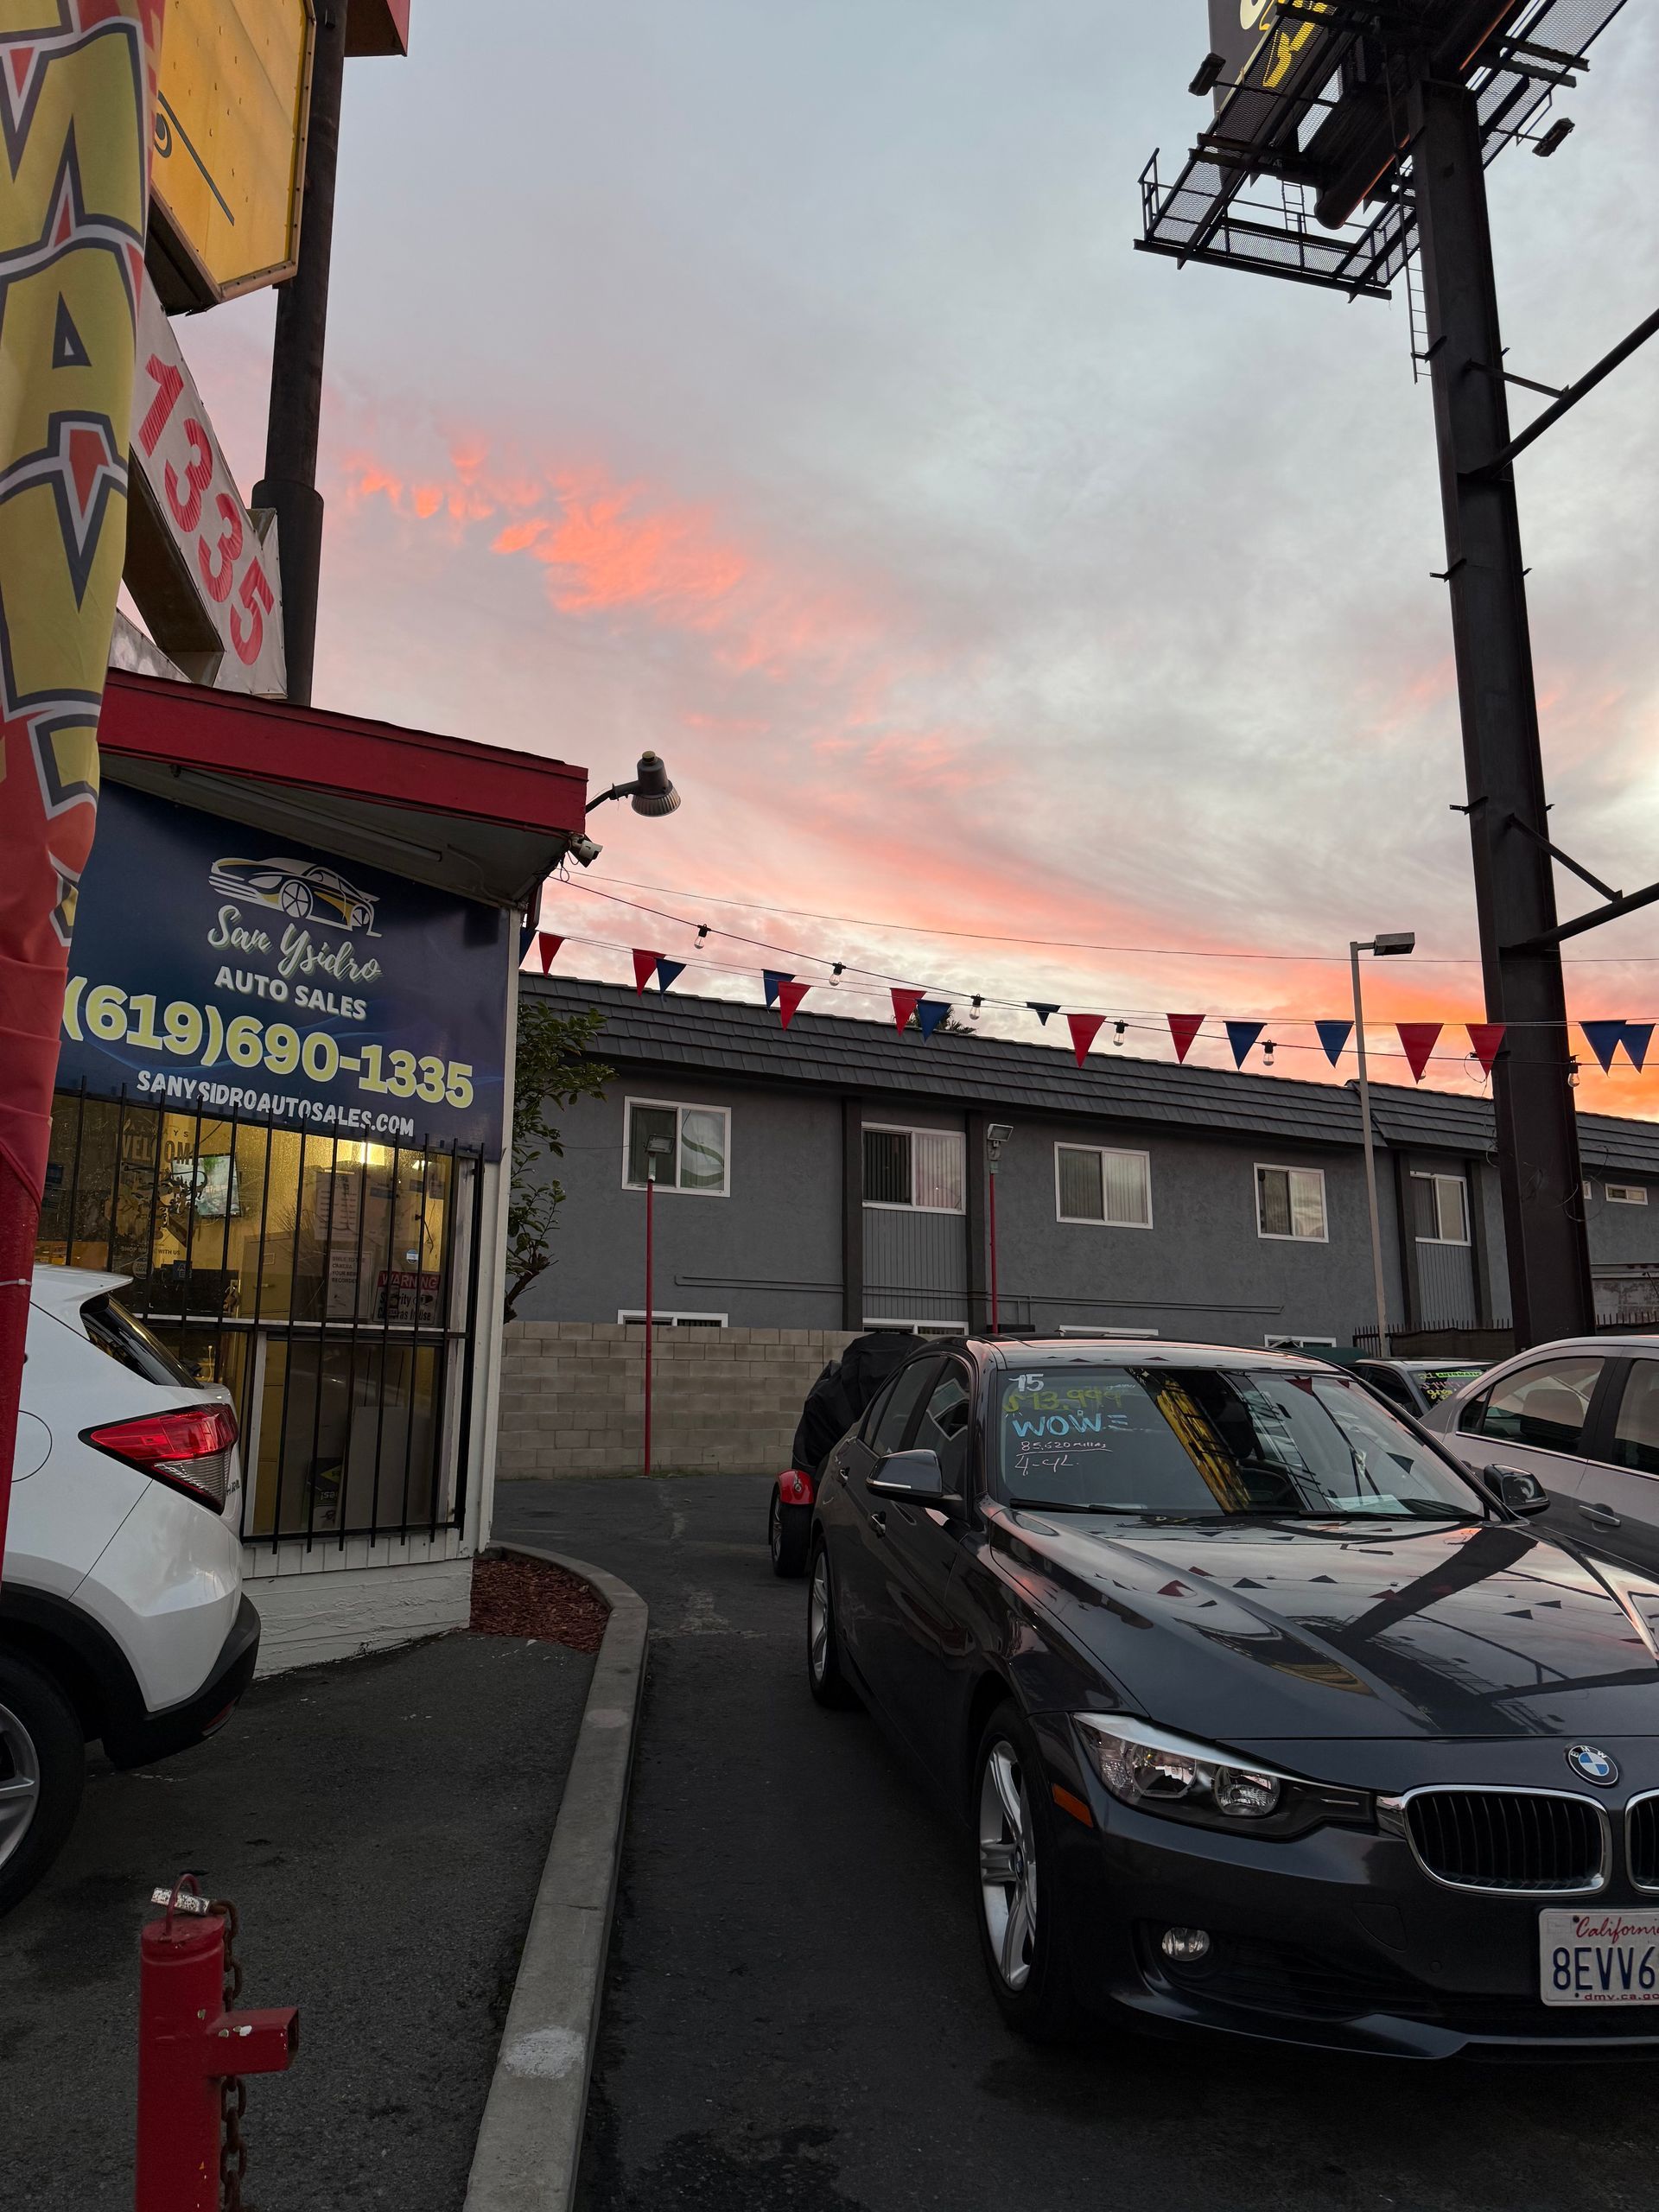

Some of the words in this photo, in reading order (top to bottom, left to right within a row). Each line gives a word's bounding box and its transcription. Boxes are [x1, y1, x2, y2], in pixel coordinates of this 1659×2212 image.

[137, 353, 275, 666] 1335
[207, 905, 272, 954] San
[276, 923, 383, 982] Ysidro
[214, 965, 289, 1002] AUTO
[295, 984, 366, 1020] SALES
[62, 976, 474, 1109] (619)690-1335
[137, 1070, 414, 1137] SANYSIDROAUTOSALES.COM
[113, 1132, 198, 1166] WELOM
[382, 1273, 437, 1288] WARNNG
[1007, 1373, 1045, 1392] 15
[1012, 1412, 1102, 1438] WOW
[1570, 1745, 1608, 1758] BMW
[1553, 1946, 1656, 1991] 8EVV6
